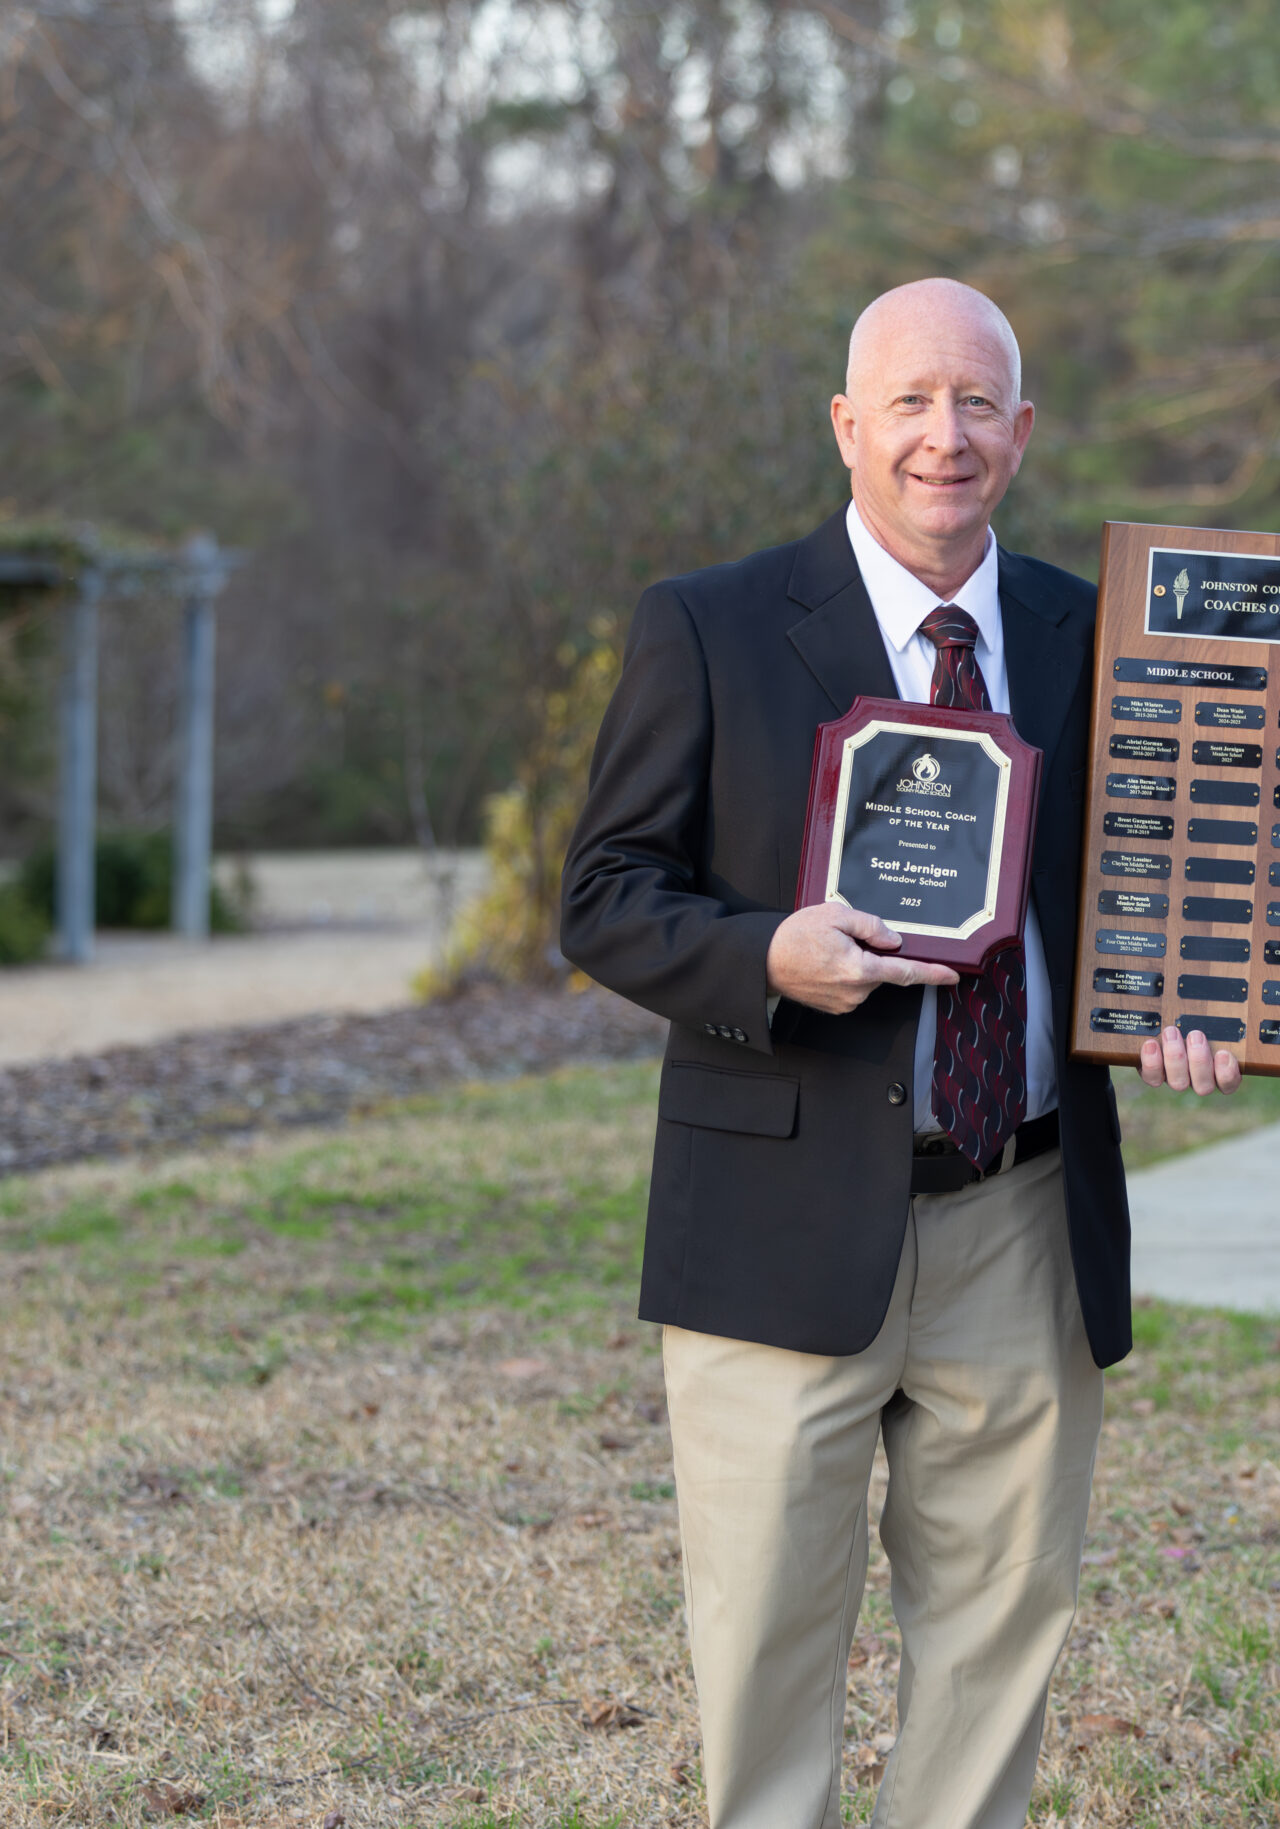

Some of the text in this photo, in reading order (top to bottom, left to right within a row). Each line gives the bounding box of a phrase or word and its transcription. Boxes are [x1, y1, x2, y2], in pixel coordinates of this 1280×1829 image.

[1200, 580, 1258, 593] JOHNSTON
[1204, 599, 1266, 614] COACHES
[1146, 667, 1234, 681] MIDDLE SCHOOL
[896, 779, 951, 792] JOHNSTON
[866, 802, 977, 822] MIDDLE SCHOOL COACH
[926, 821, 950, 832] YEAR
[898, 840, 937, 851] Presented to
[870, 857, 958, 878] Scott Jernigan
[879, 873, 947, 888] Meadow School
[900, 897, 922, 907] 2025
